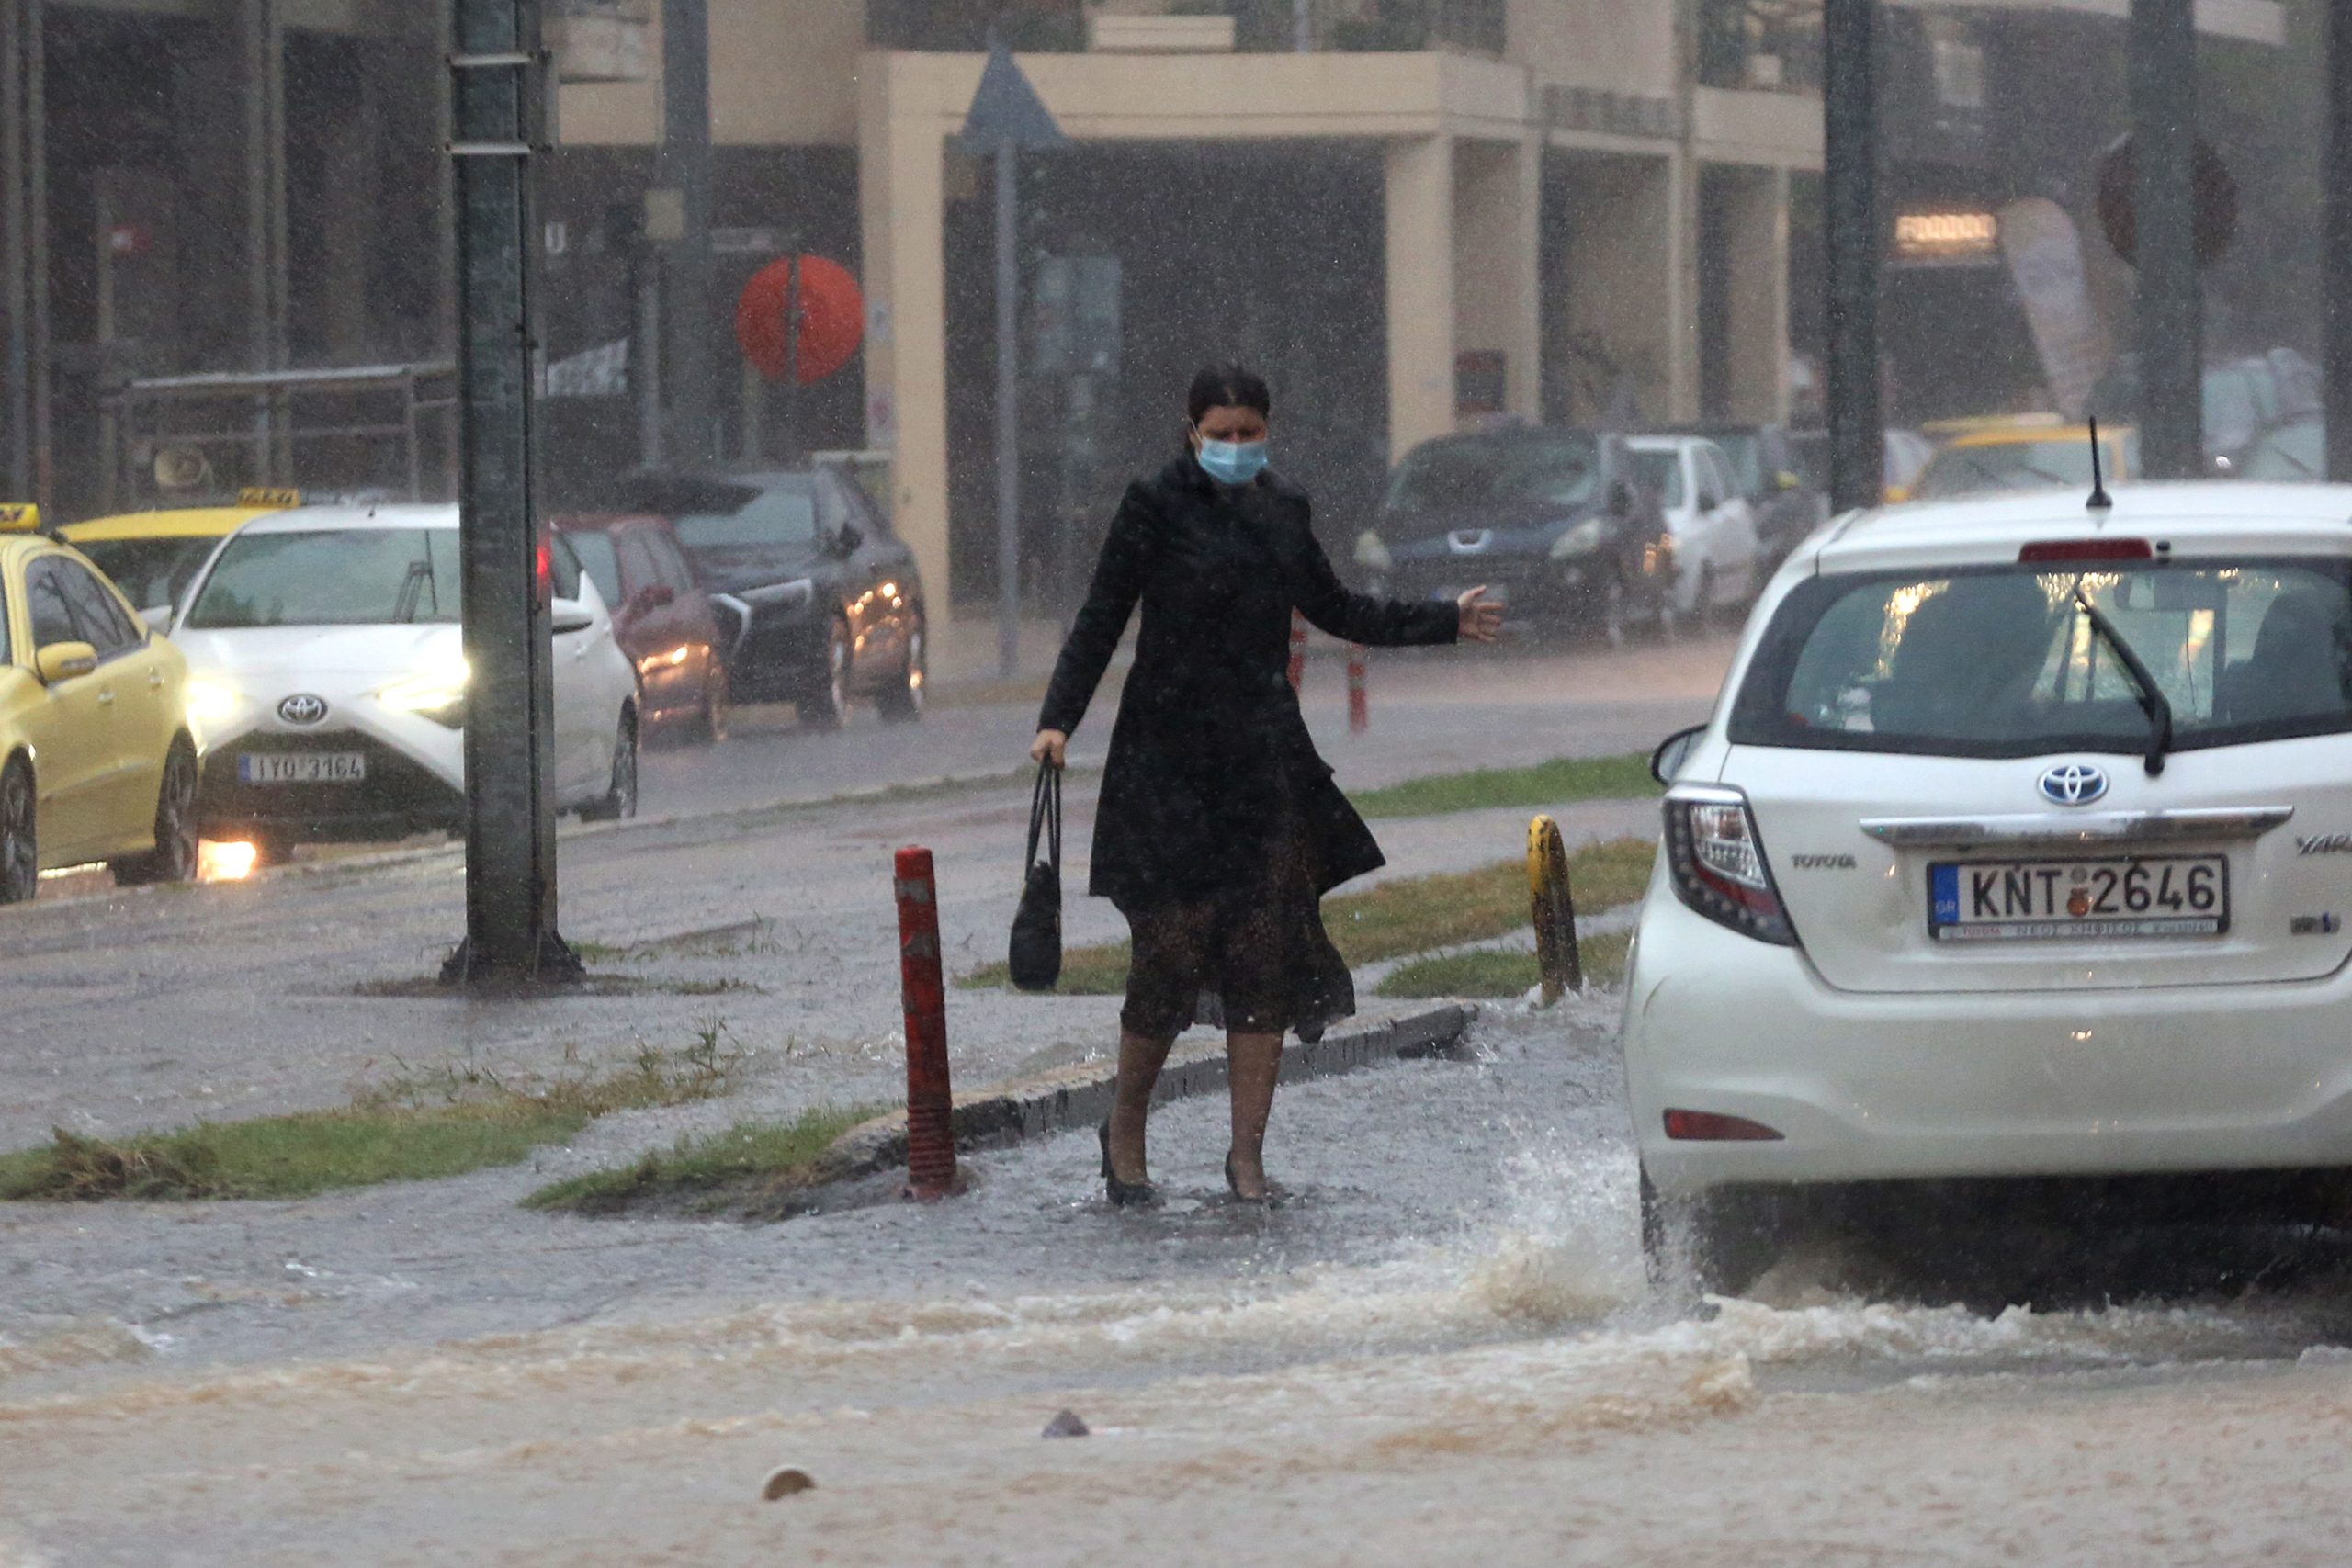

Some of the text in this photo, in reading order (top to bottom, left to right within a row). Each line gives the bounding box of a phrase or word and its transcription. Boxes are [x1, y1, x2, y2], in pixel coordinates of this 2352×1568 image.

[1791, 853, 1857, 870] TOYOTA
[1973, 864, 2216, 918] KNT 2646
[1935, 900, 1956, 914] GR
